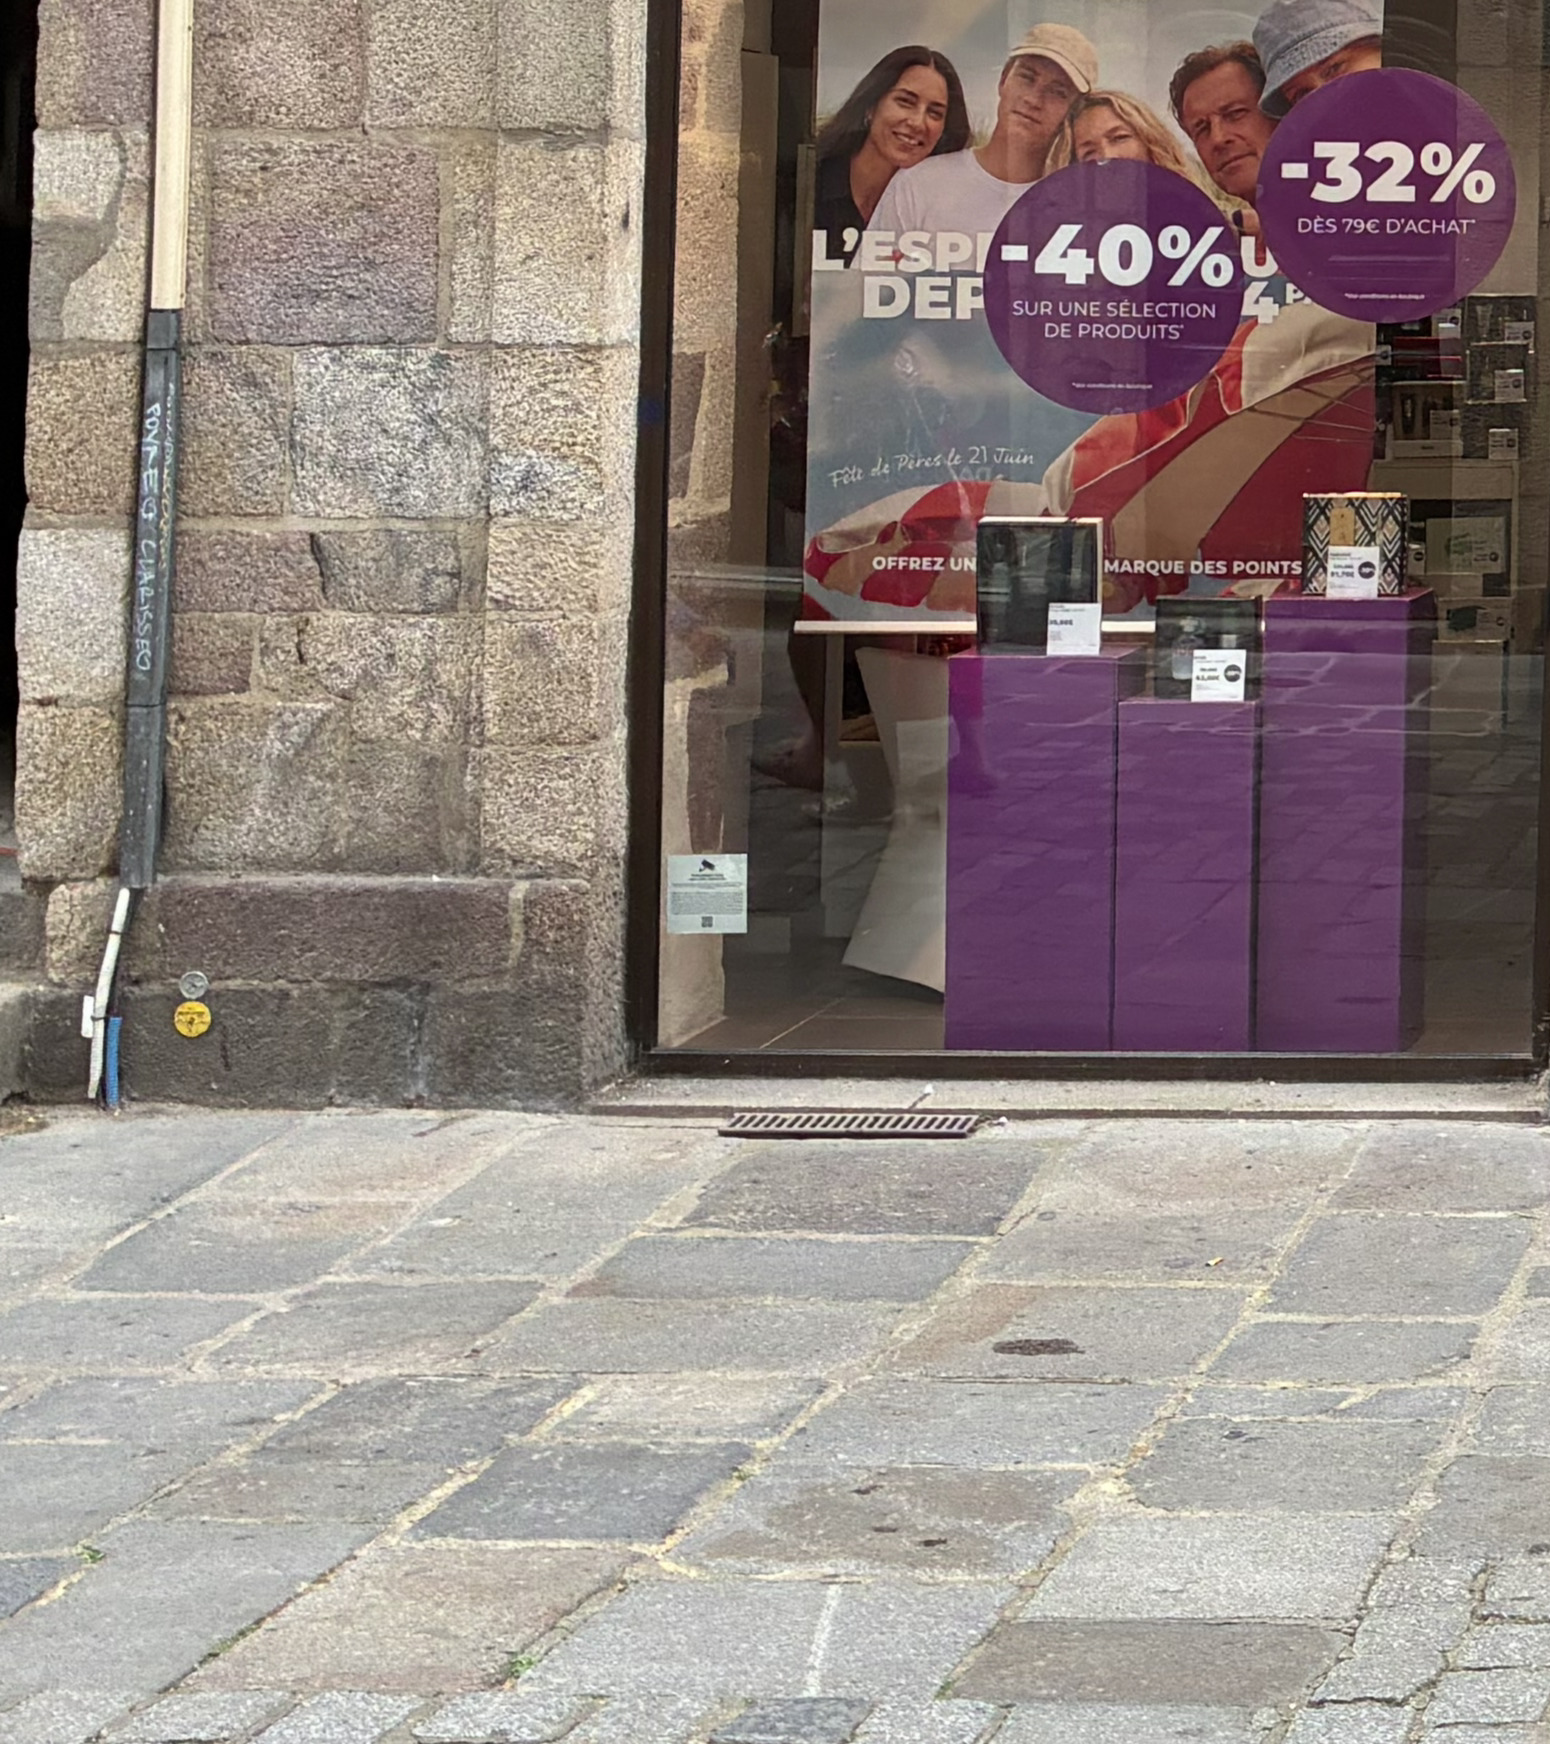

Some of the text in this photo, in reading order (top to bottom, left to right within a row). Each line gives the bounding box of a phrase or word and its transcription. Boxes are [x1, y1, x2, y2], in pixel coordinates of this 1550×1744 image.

[1280, 140, 1496, 204] -32%
[1297, 215, 1337, 234] DÈS
[1341, 218, 1380, 234] 79€
[1000, 224, 1235, 288] -40%
[1012, 296, 1217, 319] SUR UNE SÉLECTION
[1044, 322, 1073, 339] DE
[968, 445, 987, 465] 21
[993, 447, 1034, 465] Juin
[872, 556, 945, 571] OFFREZ
[1104, 559, 1185, 576] MARQUE
[1190, 560, 1228, 575] DES
[1232, 560, 1303, 576] POINTS
